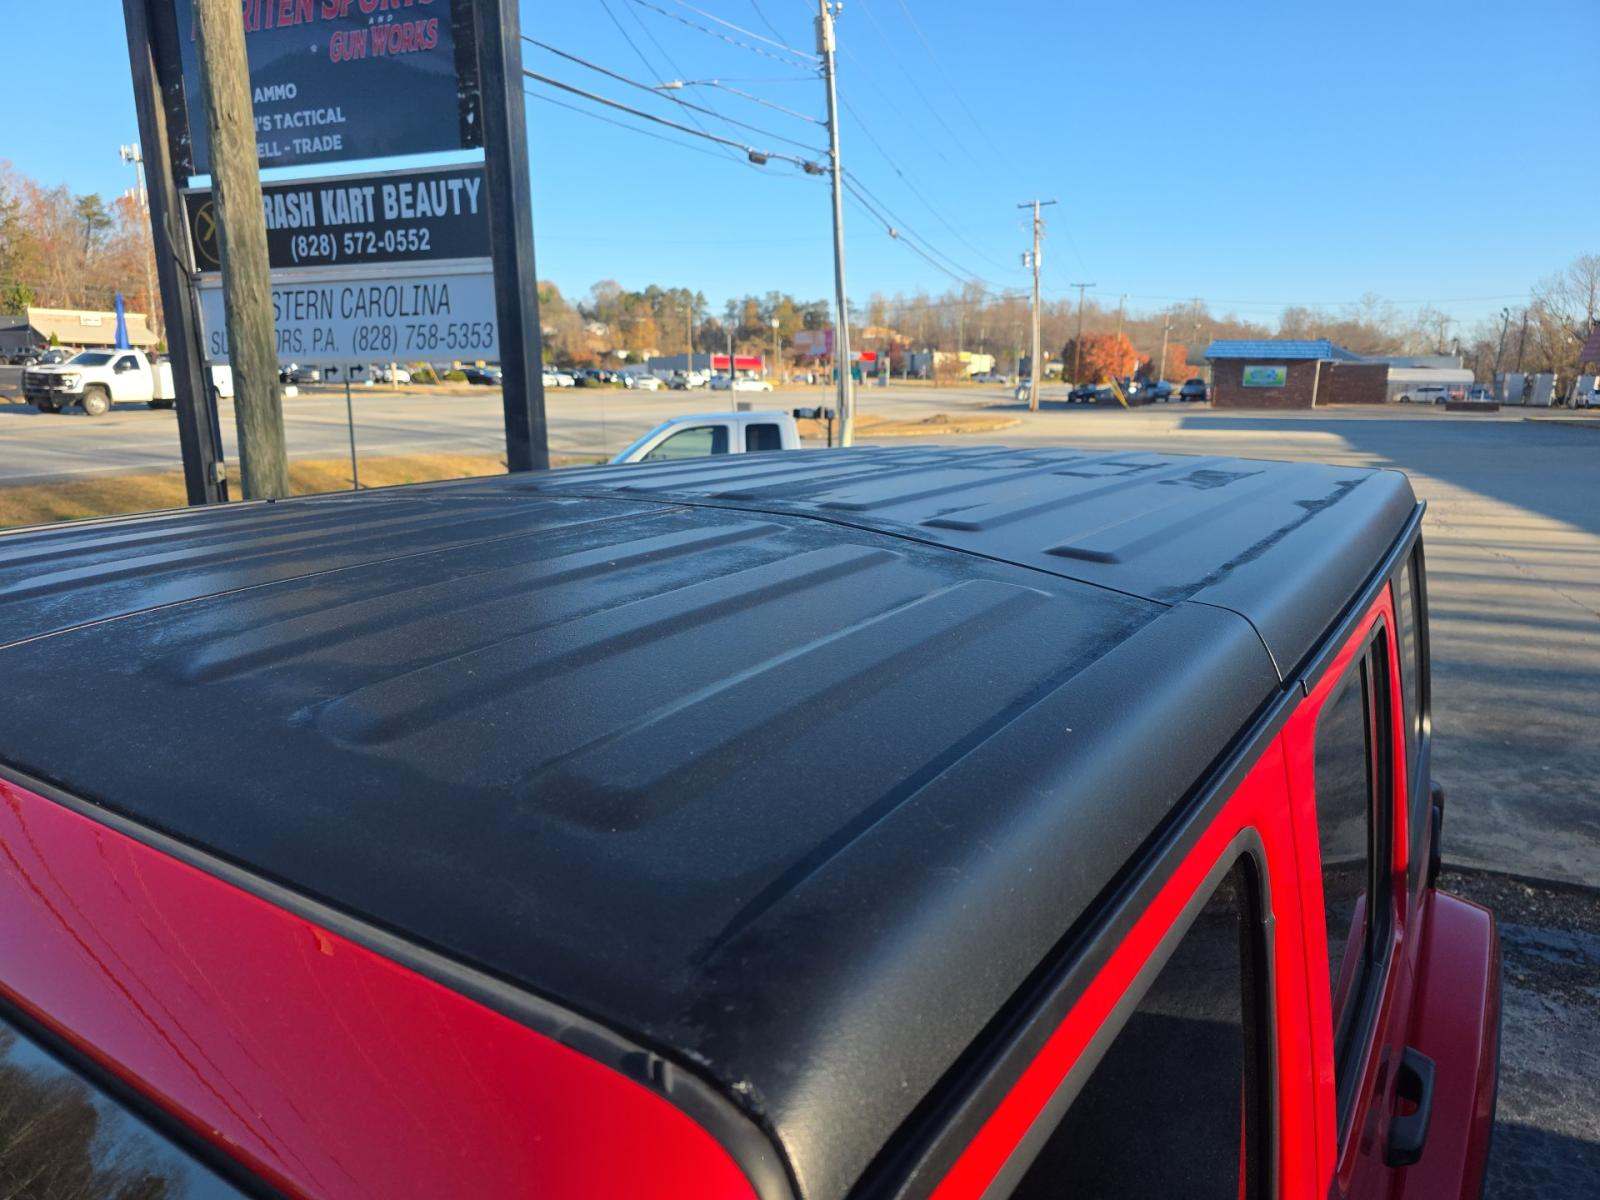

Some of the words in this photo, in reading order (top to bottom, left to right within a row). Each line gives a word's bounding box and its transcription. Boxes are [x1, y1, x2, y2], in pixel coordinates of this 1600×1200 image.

[329, 29, 368, 63] GUN
[370, 18, 439, 56] WORKS
[254, 83, 297, 103] AMMO
[273, 107, 346, 129] TACTICAL
[256, 141, 282, 158] ELL
[292, 134, 343, 154] TRADE
[263, 191, 316, 230] RASH
[320, 186, 375, 226] KART
[381, 176, 481, 220] BEAUTY
[291, 233, 338, 263] (828)
[343, 227, 431, 255] 572-0552
[272, 288, 334, 322] STERN
[341, 283, 451, 319] CAROLINA
[352, 324, 398, 355] (828)
[405, 322, 494, 350] 758-5353
